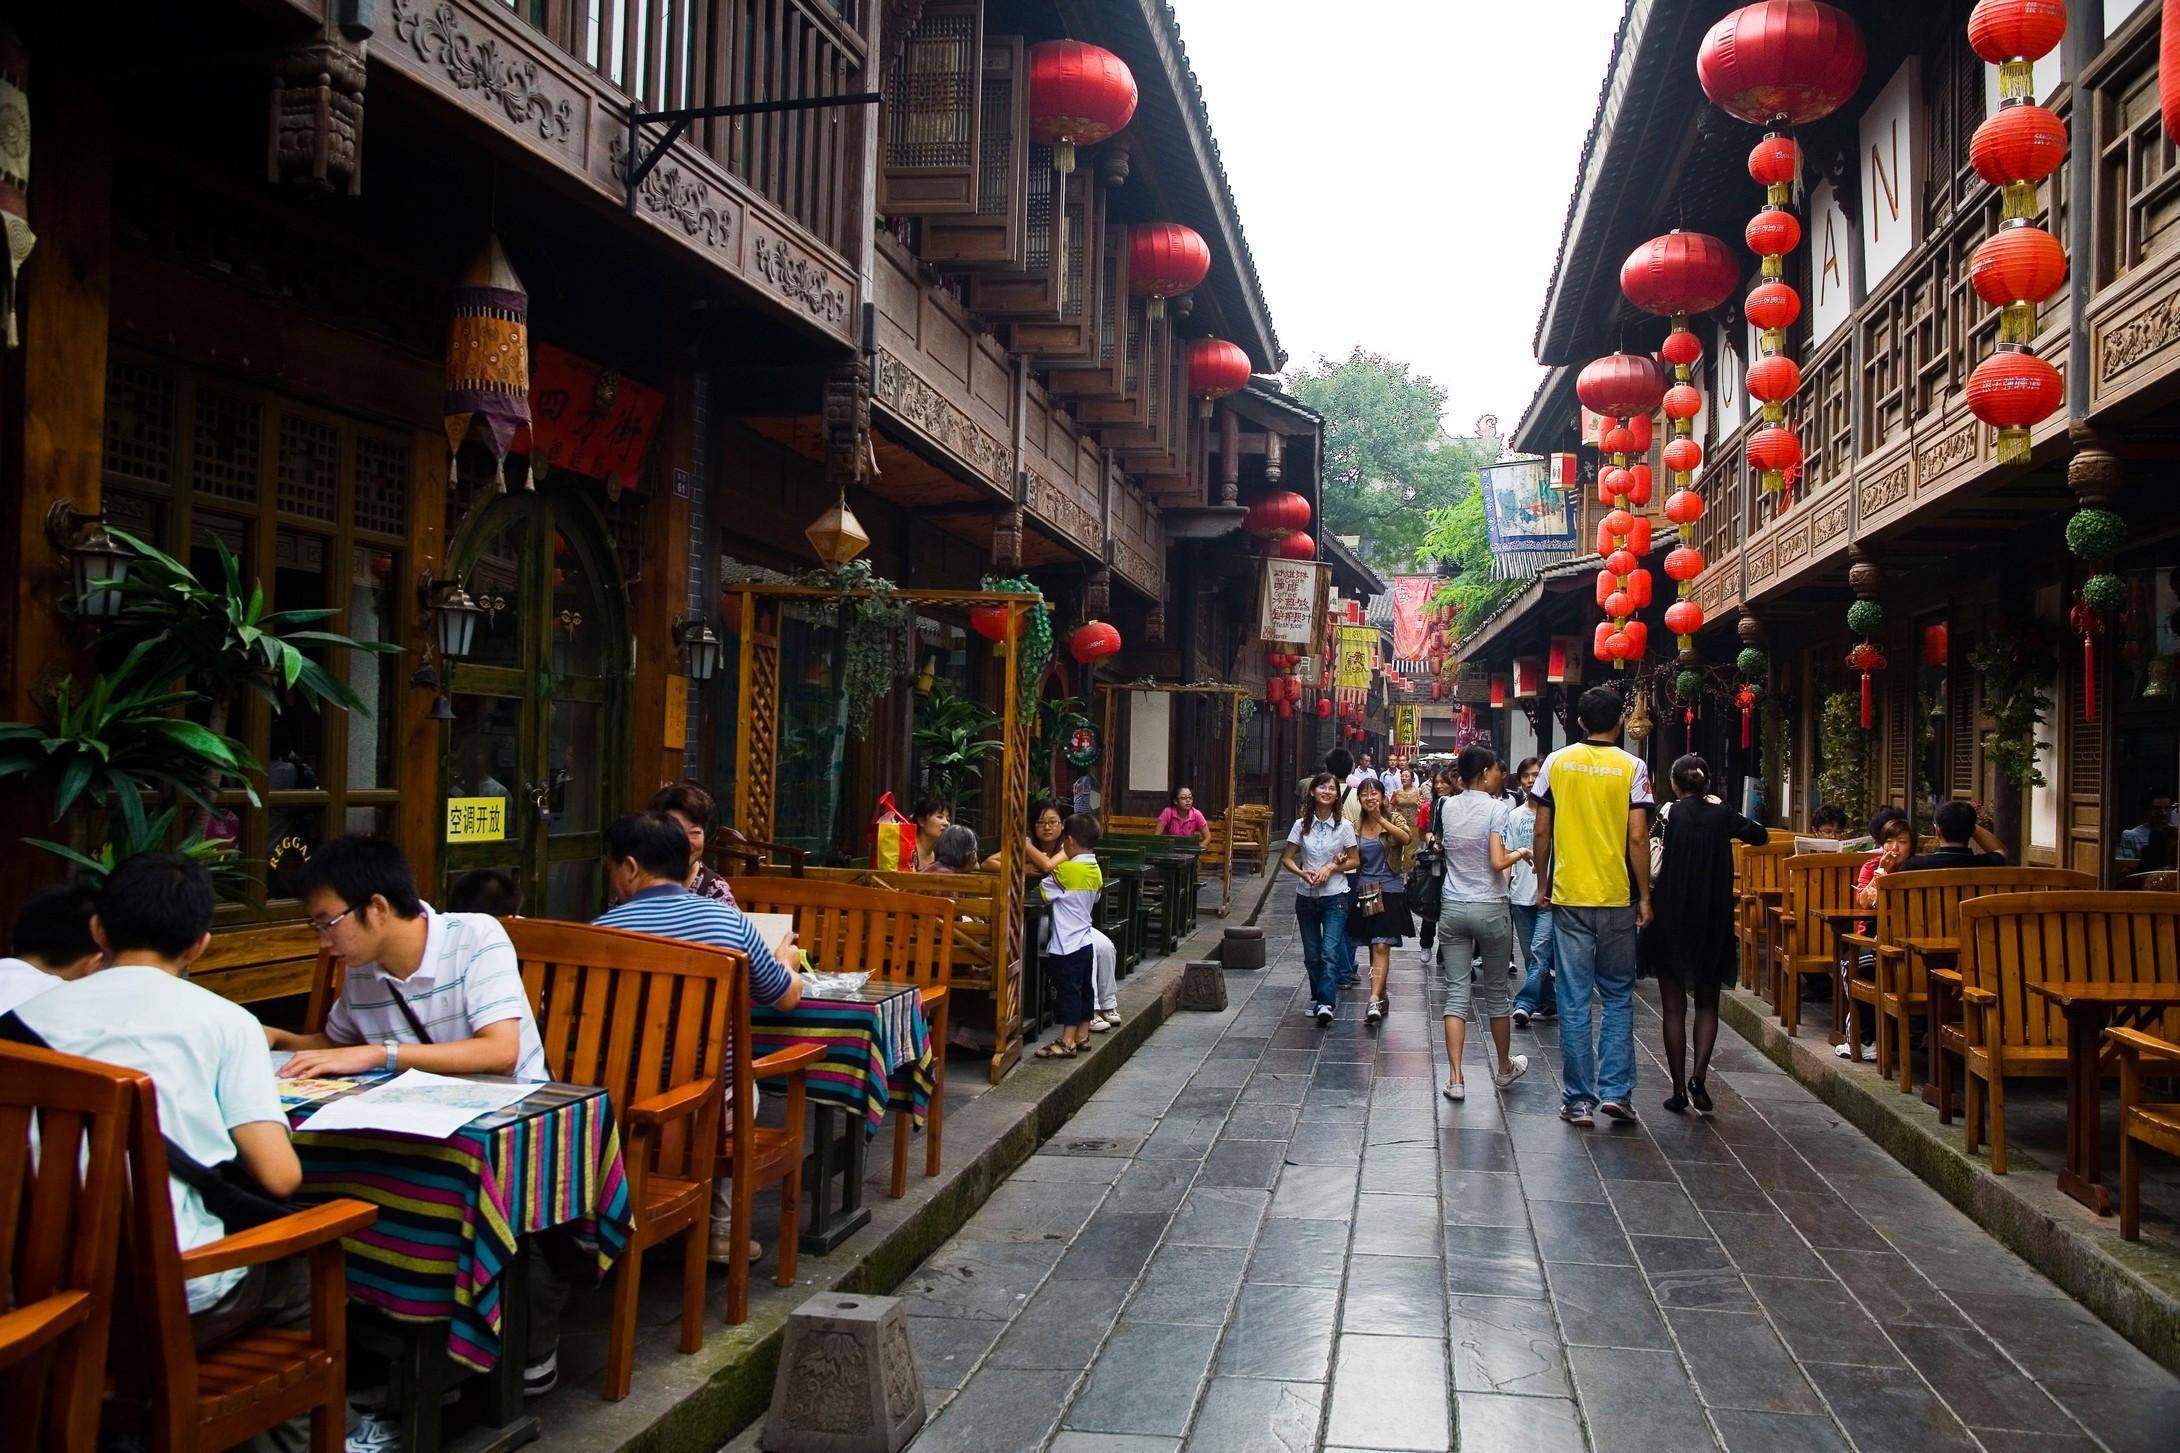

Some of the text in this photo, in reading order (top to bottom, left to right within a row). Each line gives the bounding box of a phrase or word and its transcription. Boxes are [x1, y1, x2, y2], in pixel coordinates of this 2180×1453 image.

[1564, 760, 1622, 776] Kappa
[449, 804, 501, 834] 空调开放
